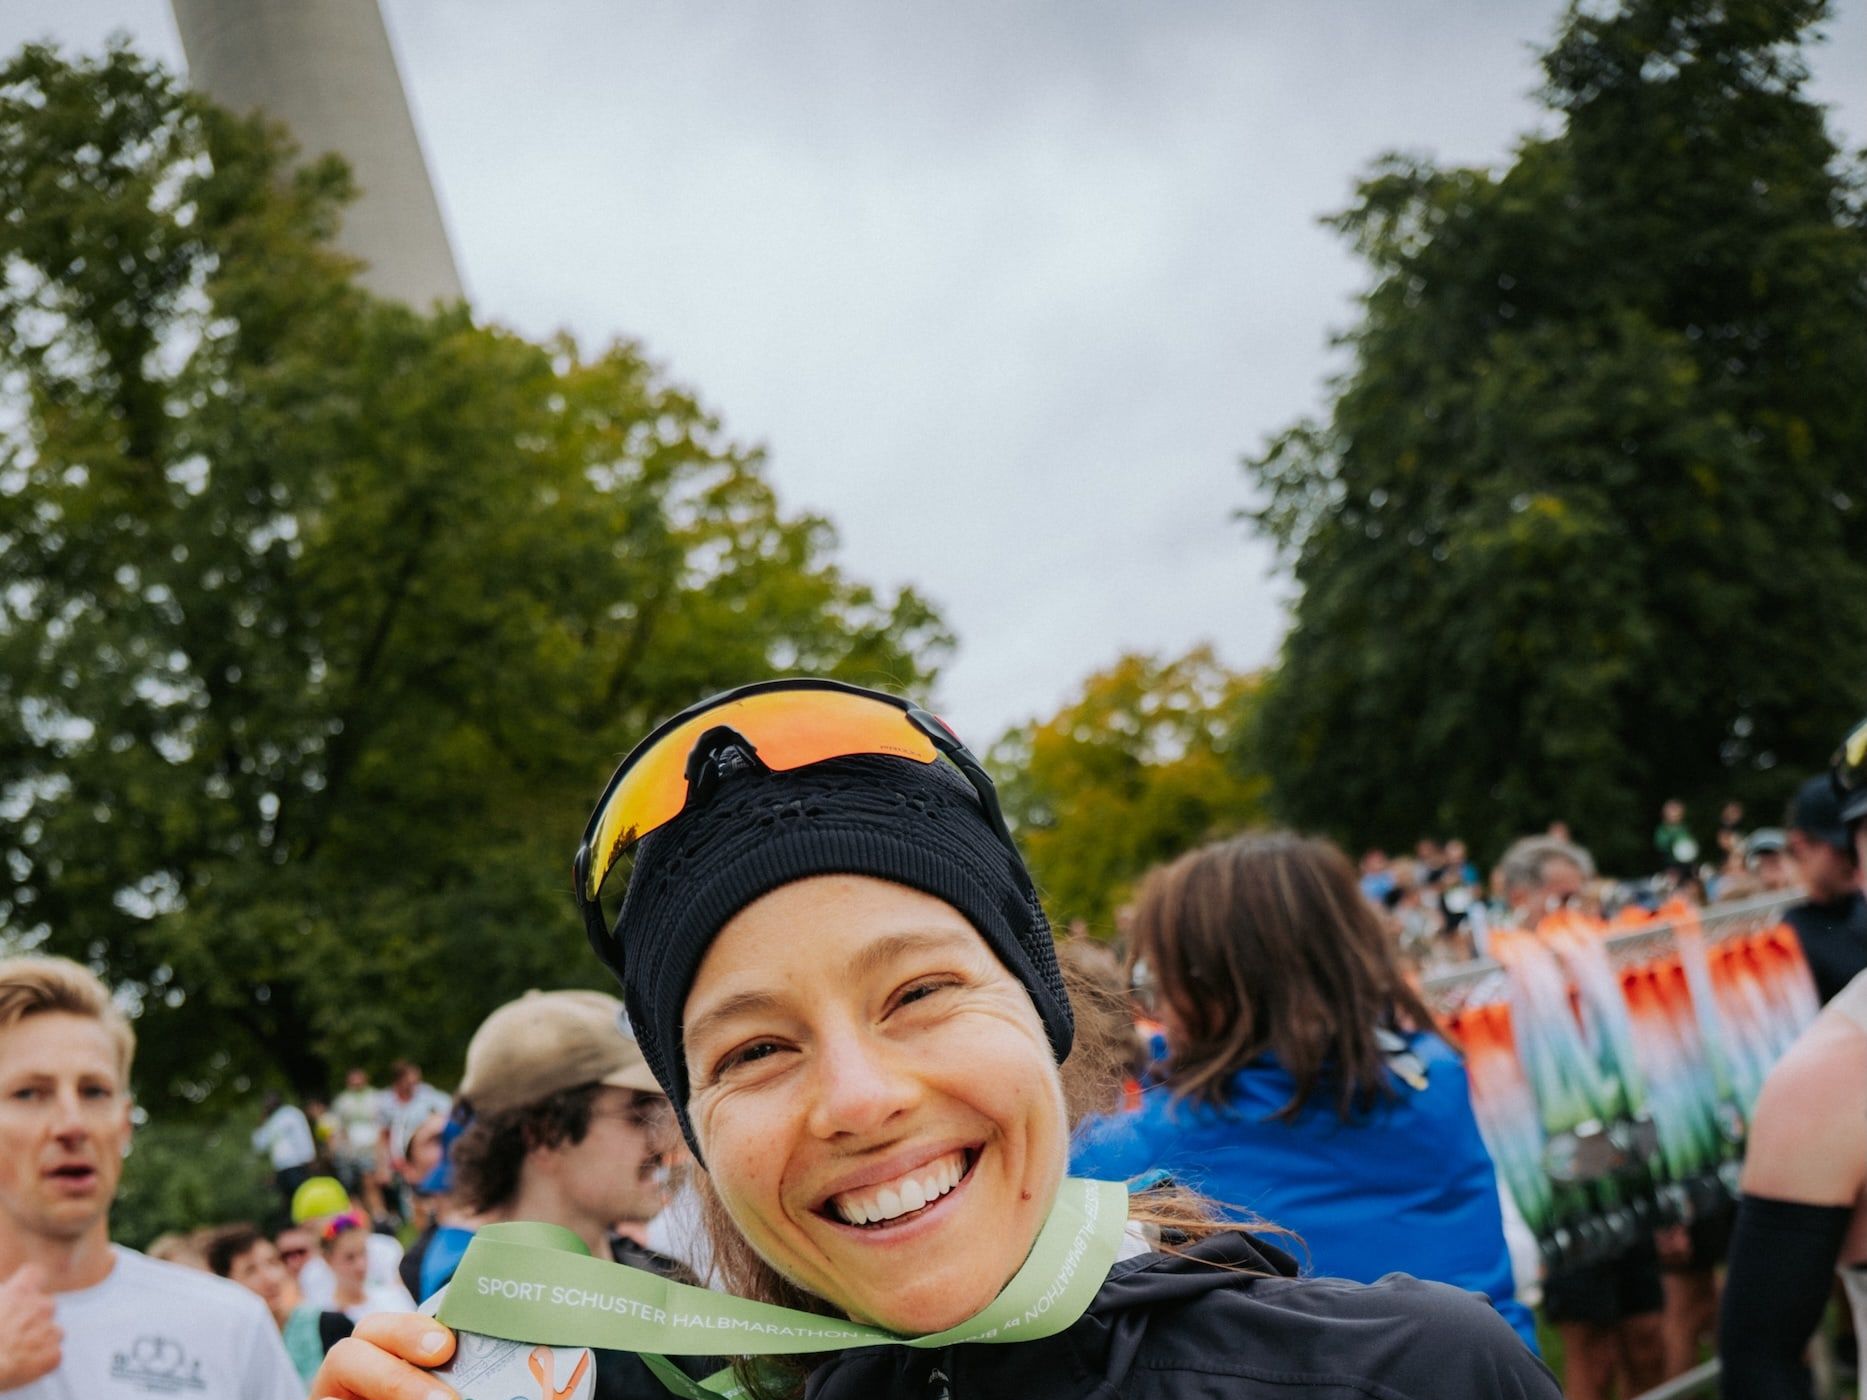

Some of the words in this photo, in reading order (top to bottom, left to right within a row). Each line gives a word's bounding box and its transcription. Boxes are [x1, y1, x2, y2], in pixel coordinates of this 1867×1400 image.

[477, 1276, 546, 1301] SPORT
[550, 1285, 666, 1325] SCHUSTER
[672, 1312, 858, 1339] HALBMARATHON
[1025, 1217, 1098, 1325] HALBMARATHON
